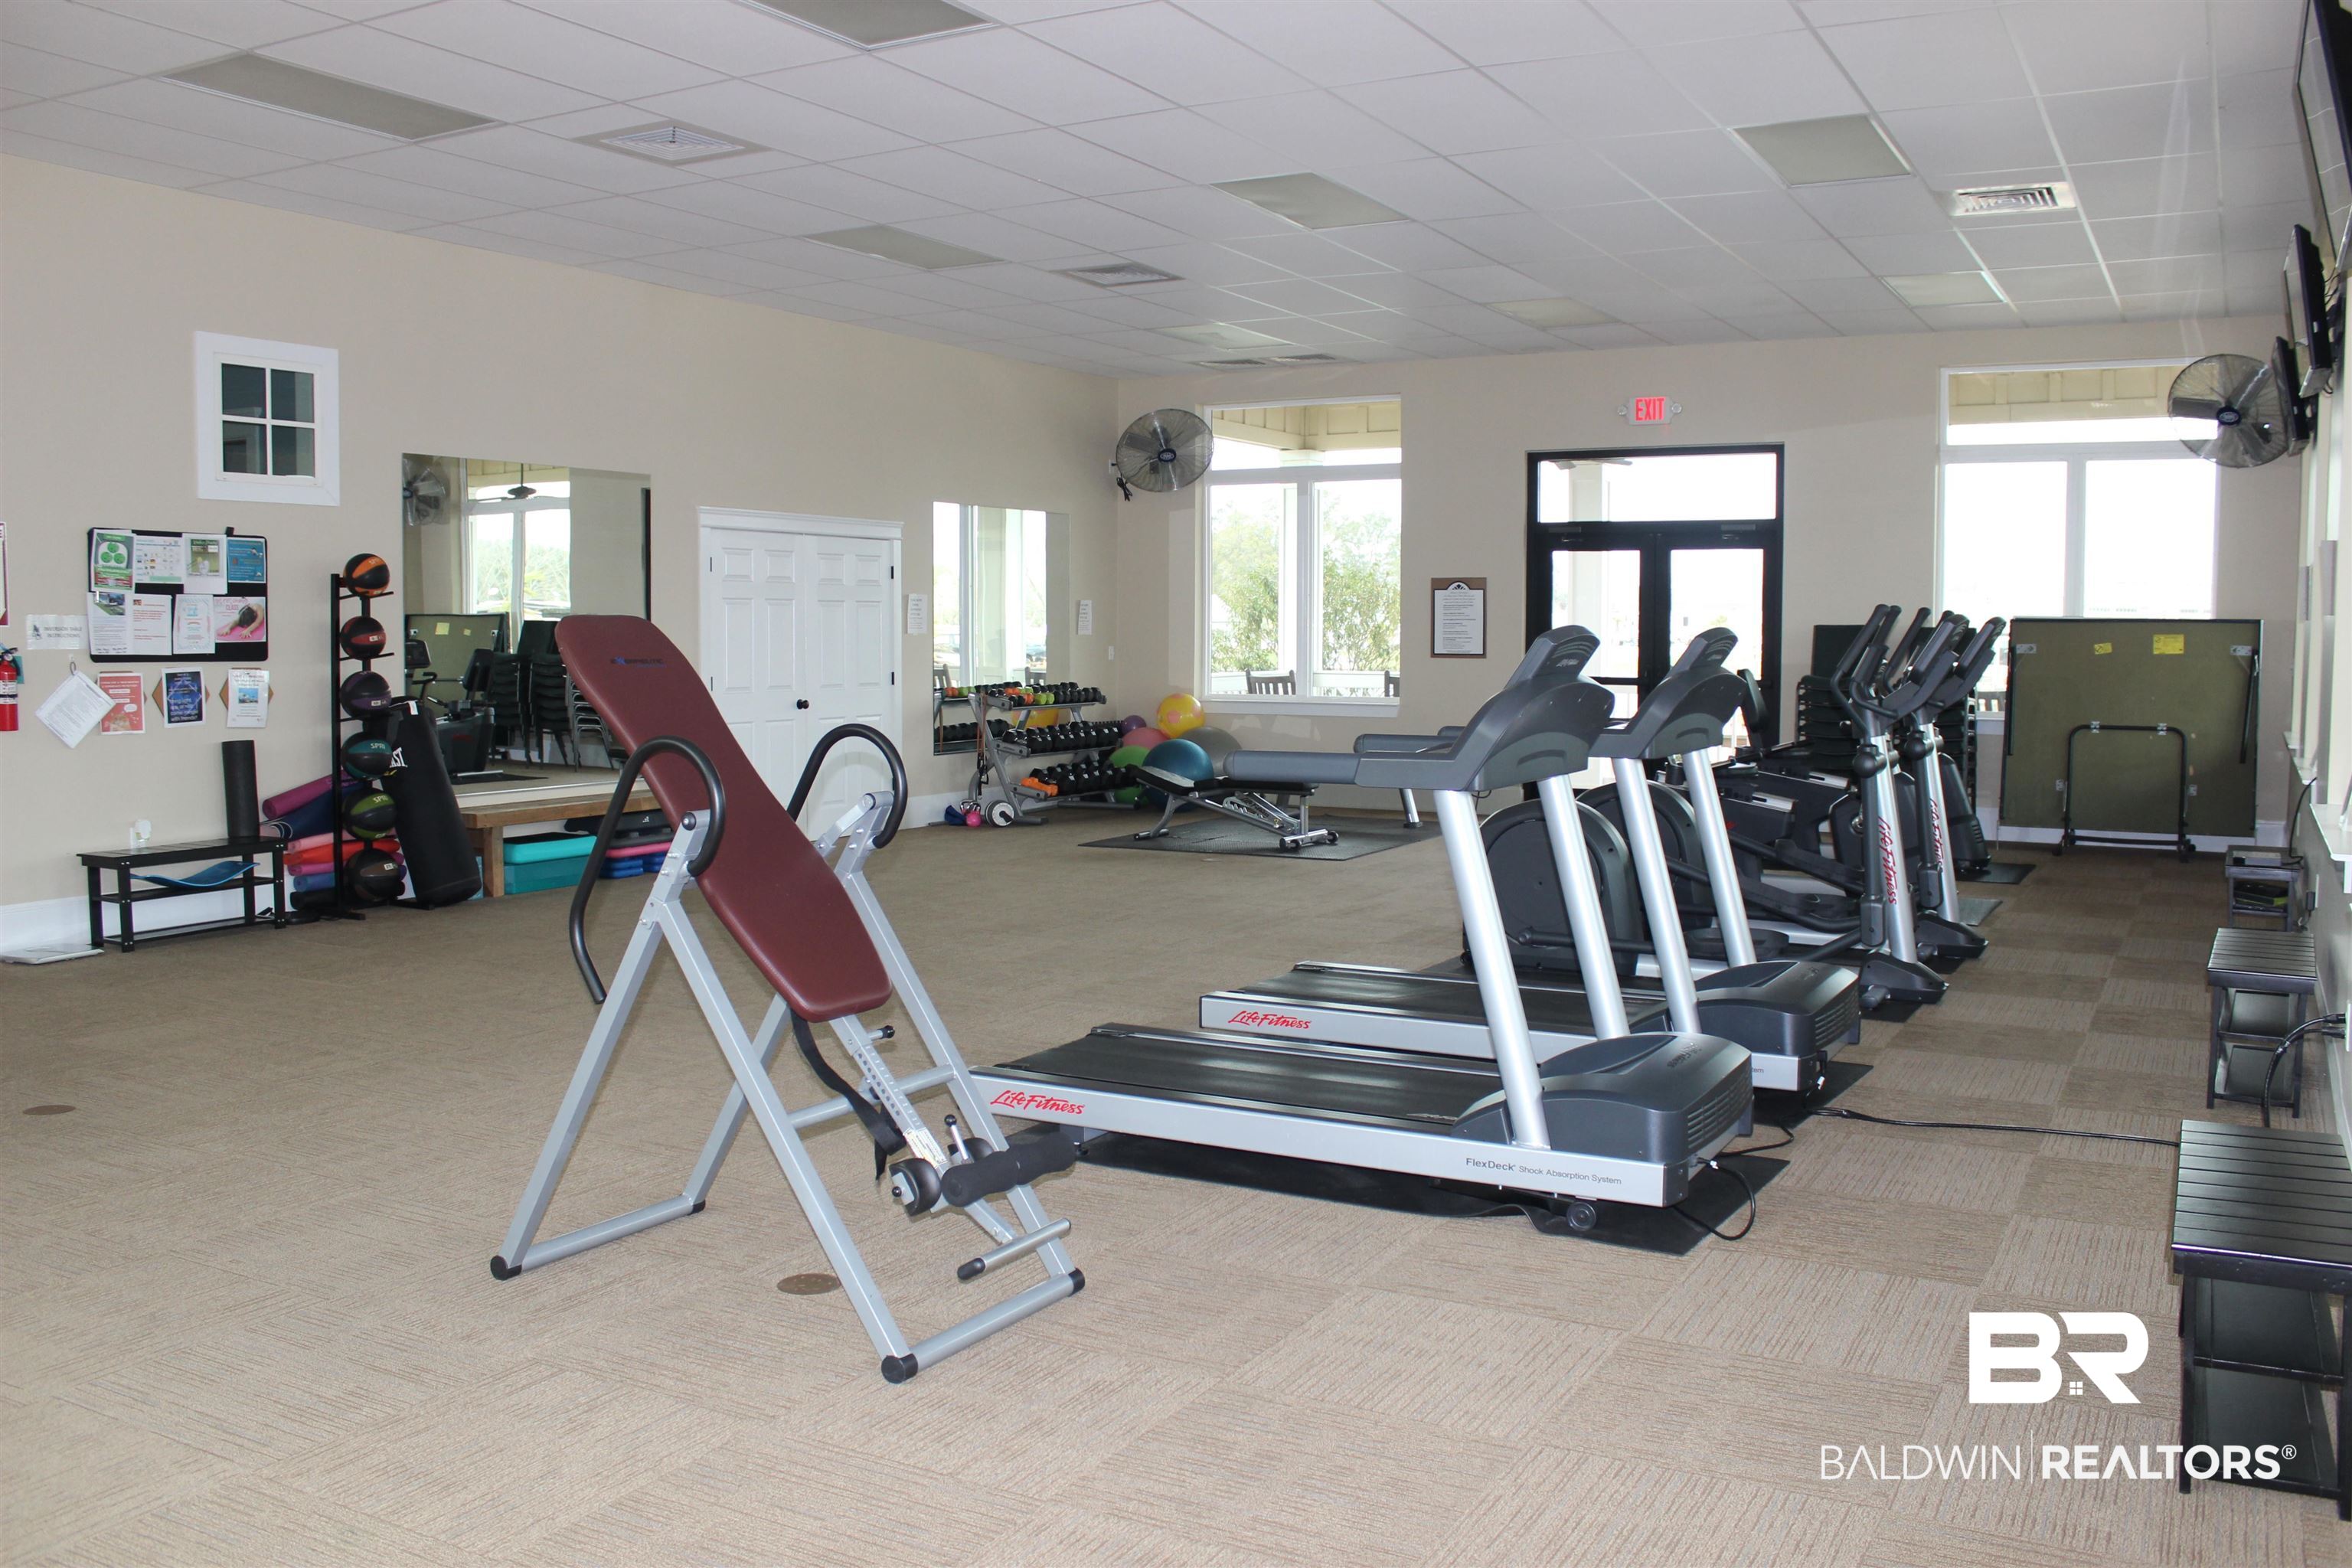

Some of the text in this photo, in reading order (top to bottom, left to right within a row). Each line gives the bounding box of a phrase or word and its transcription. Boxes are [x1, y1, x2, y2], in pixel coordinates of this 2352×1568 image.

[1635, 397, 1665, 421] EXIT
[1518, 1165, 1544, 1176] Shock
[1546, 1168, 1590, 1181] Absorption
[1591, 1174, 1622, 1185] System
